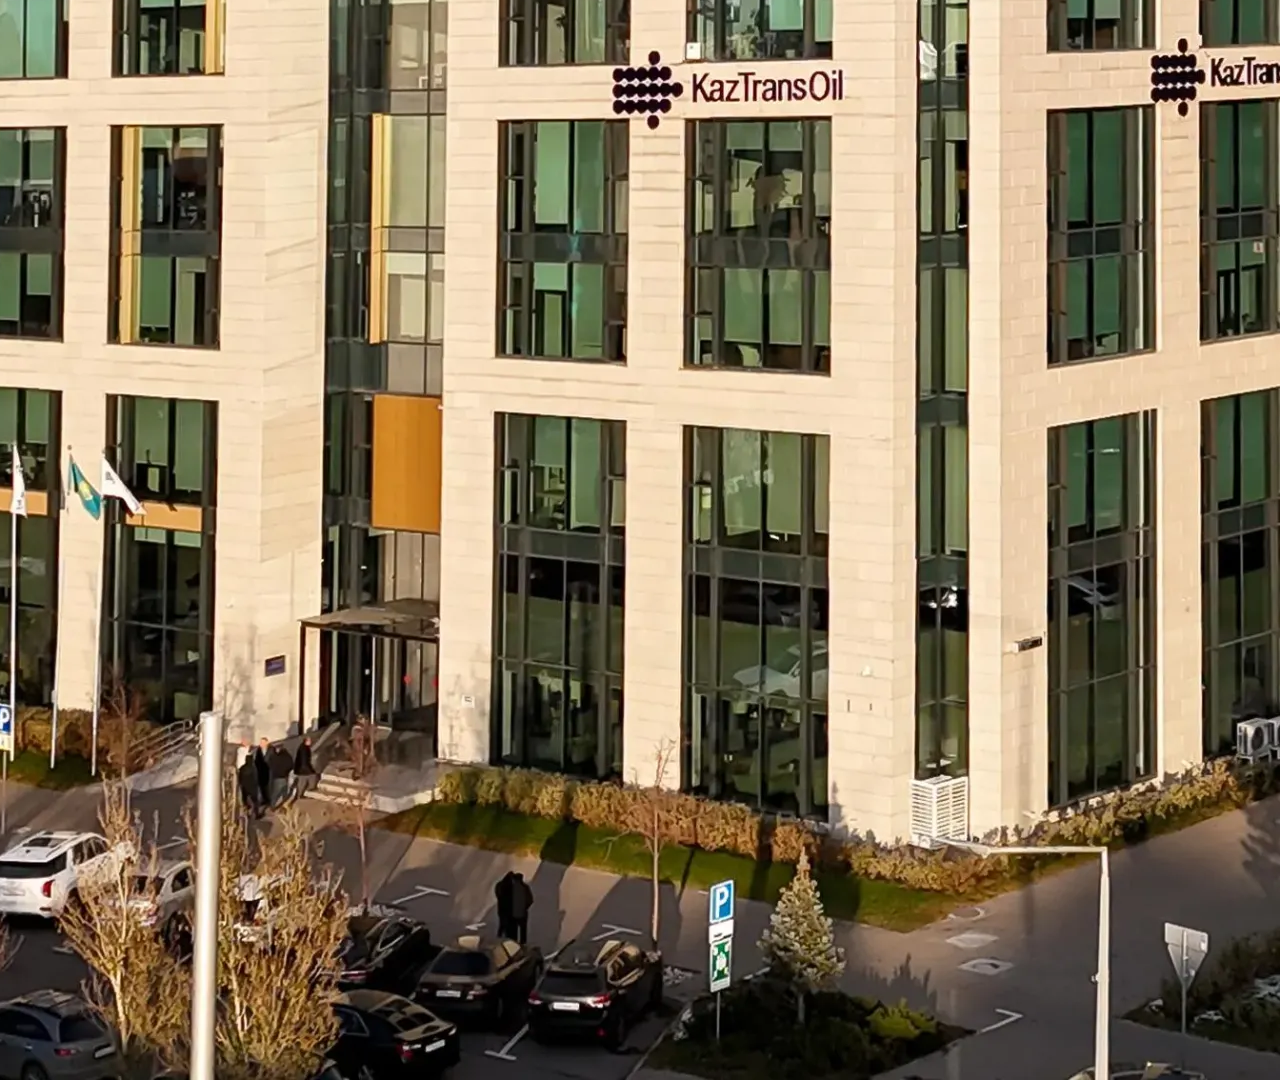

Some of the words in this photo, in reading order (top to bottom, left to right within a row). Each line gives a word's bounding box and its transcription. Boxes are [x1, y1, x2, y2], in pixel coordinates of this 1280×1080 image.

[692, 70, 844, 102] KazTransOil
[0, 708, 10, 730] P
[715, 887, 729, 919] P
